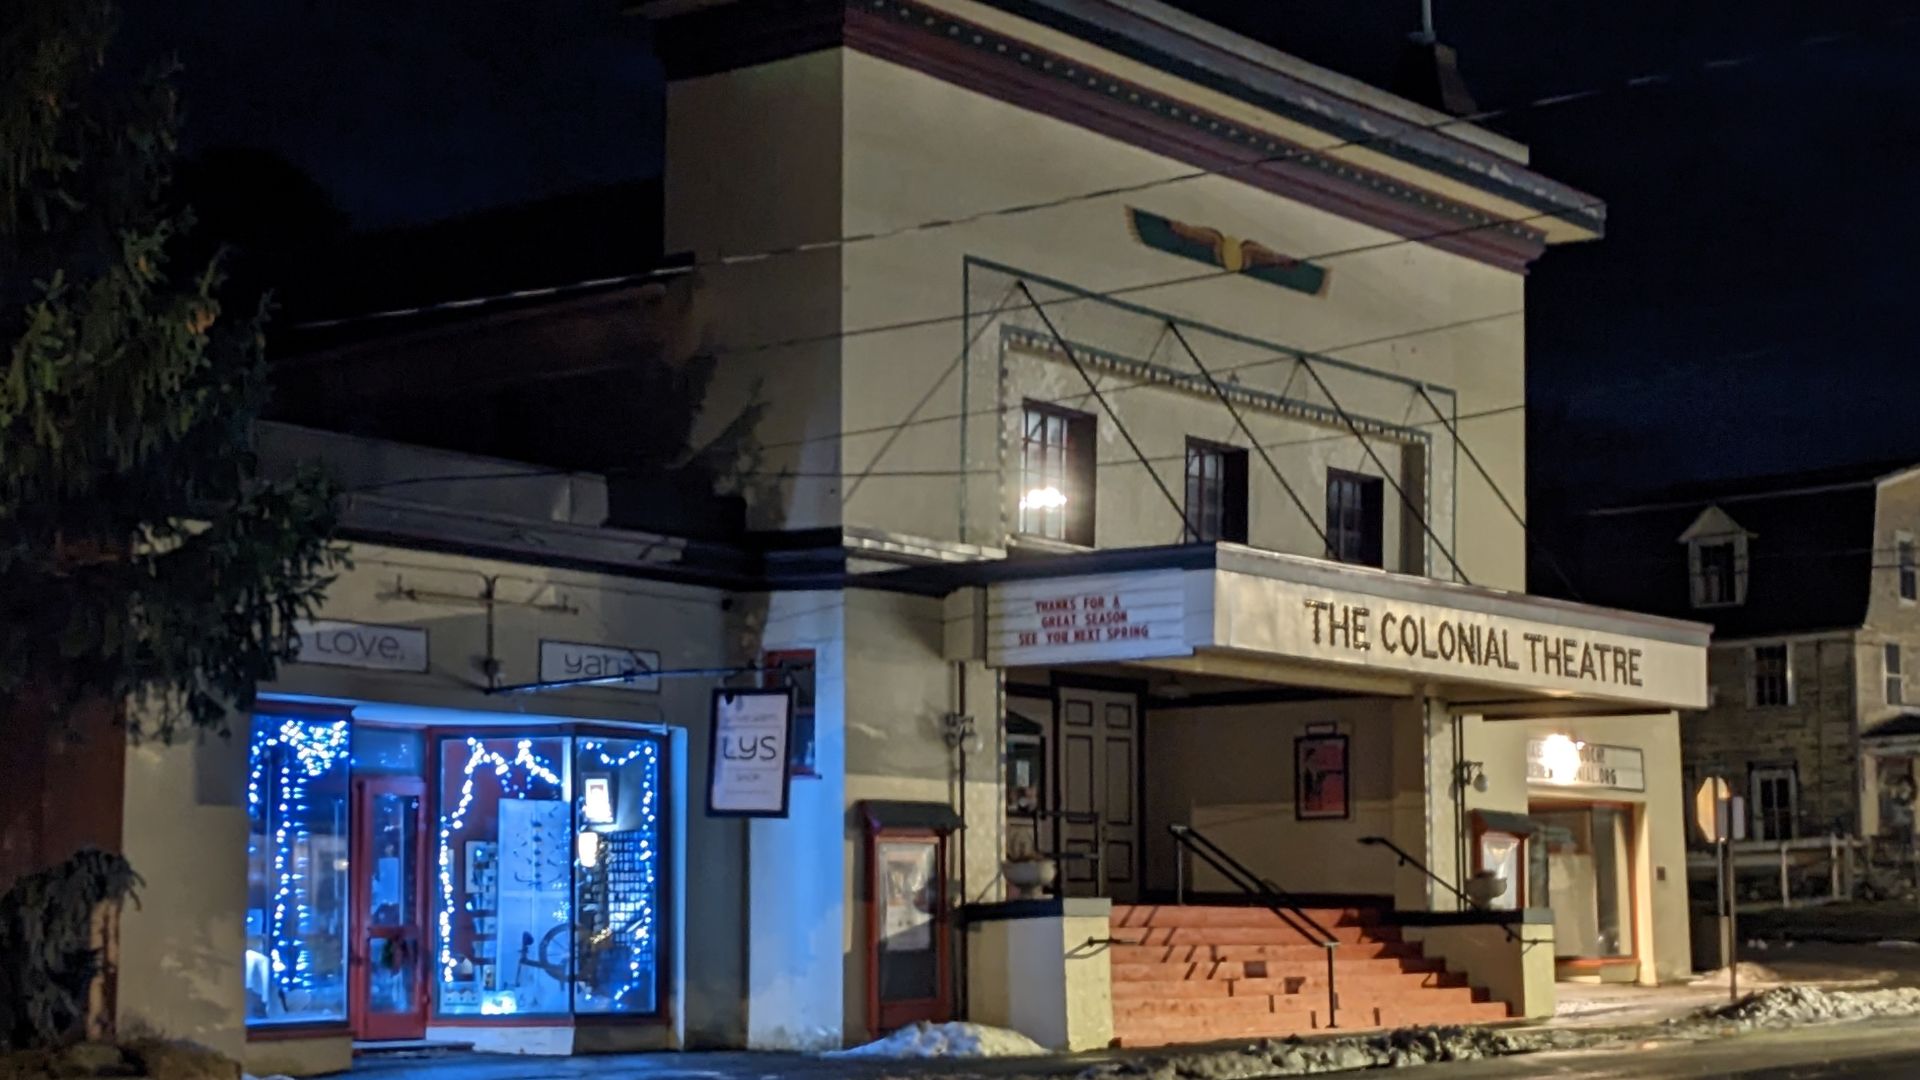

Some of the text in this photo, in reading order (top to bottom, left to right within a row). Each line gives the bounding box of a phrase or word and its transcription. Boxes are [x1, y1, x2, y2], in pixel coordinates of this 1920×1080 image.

[1035, 595, 1121, 612] THANKS FOR A
[1041, 611, 1128, 628] GREAT SEASON
[1018, 624, 1149, 646] SEE YOU NEXT SPRING
[1304, 599, 1643, 686] THE COLONIAL THEATRE
